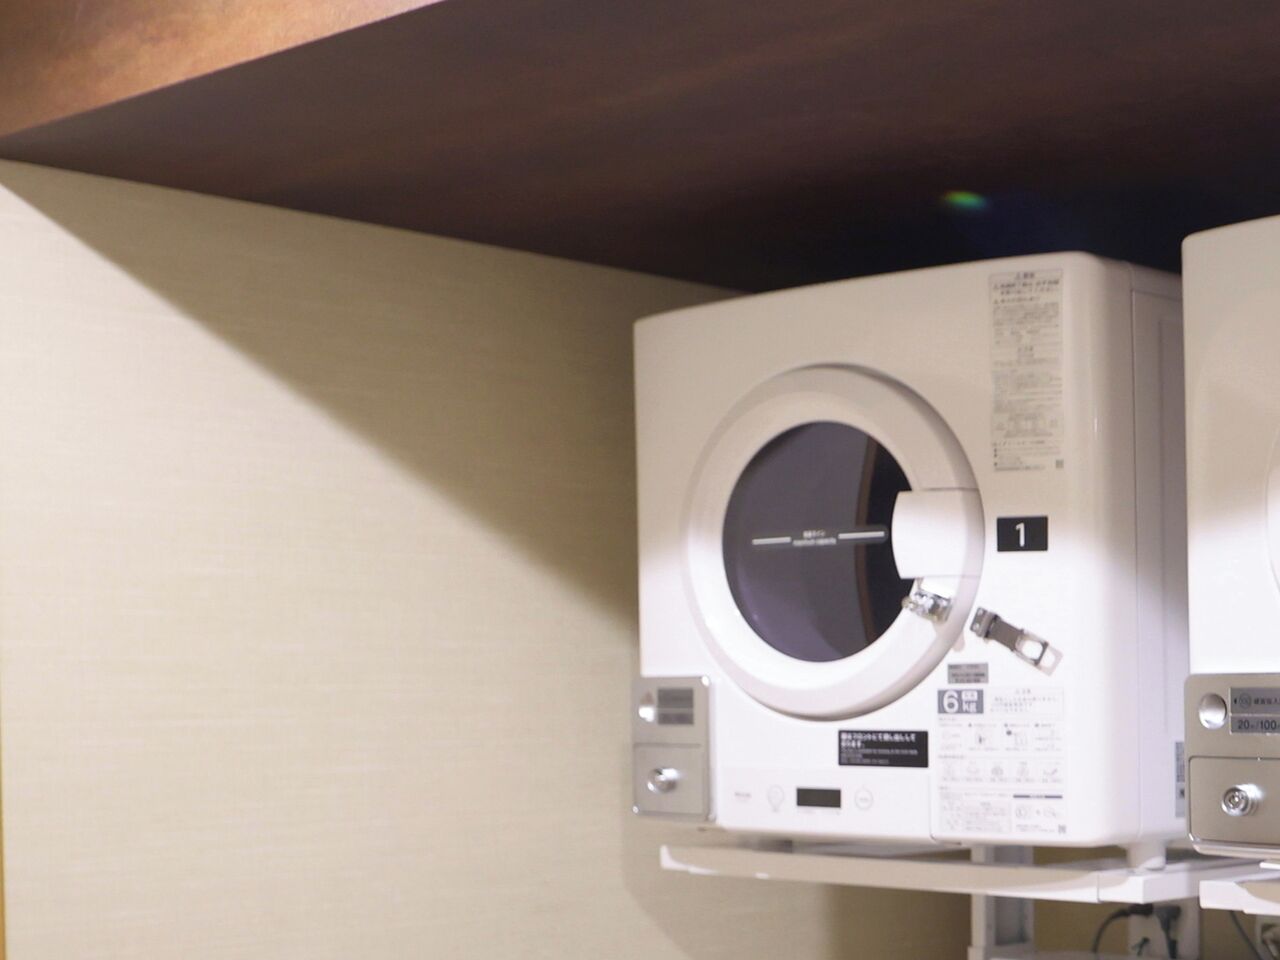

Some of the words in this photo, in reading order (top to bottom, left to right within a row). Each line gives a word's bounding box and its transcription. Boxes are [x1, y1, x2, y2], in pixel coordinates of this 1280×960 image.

[1015, 523, 1026, 547] 1
[943, 692, 959, 713] 6
[962, 698, 977, 713] kg
